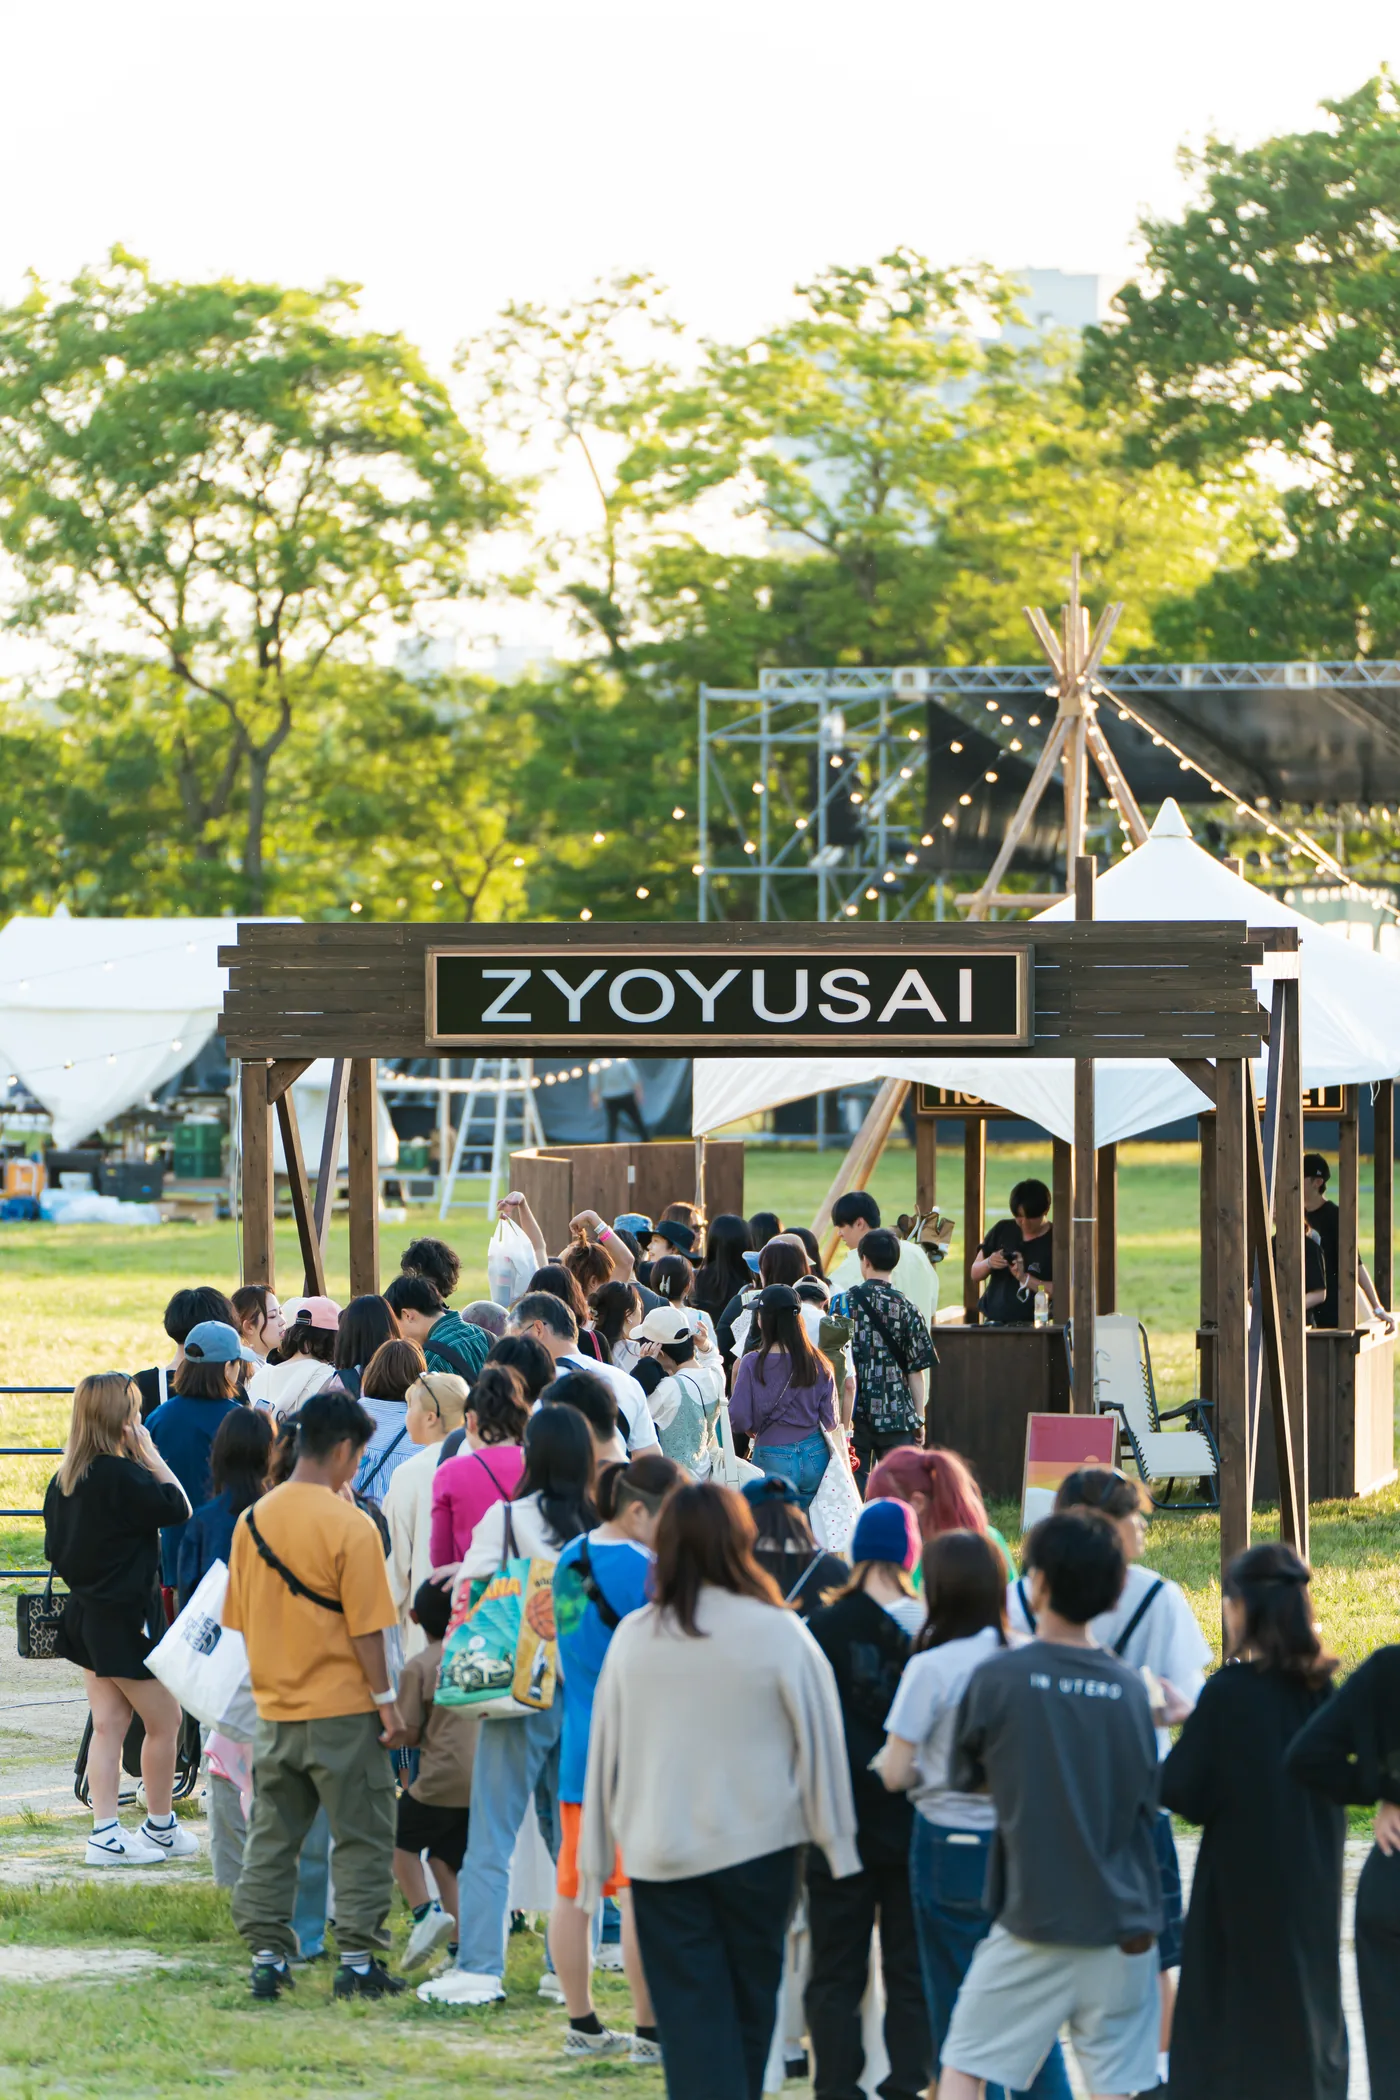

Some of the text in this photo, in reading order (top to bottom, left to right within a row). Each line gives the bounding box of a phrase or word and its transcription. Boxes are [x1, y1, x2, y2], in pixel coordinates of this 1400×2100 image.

[481, 968, 972, 1023] ZYOYUSAI
[1030, 1672, 1122, 1700] IN UTERO
